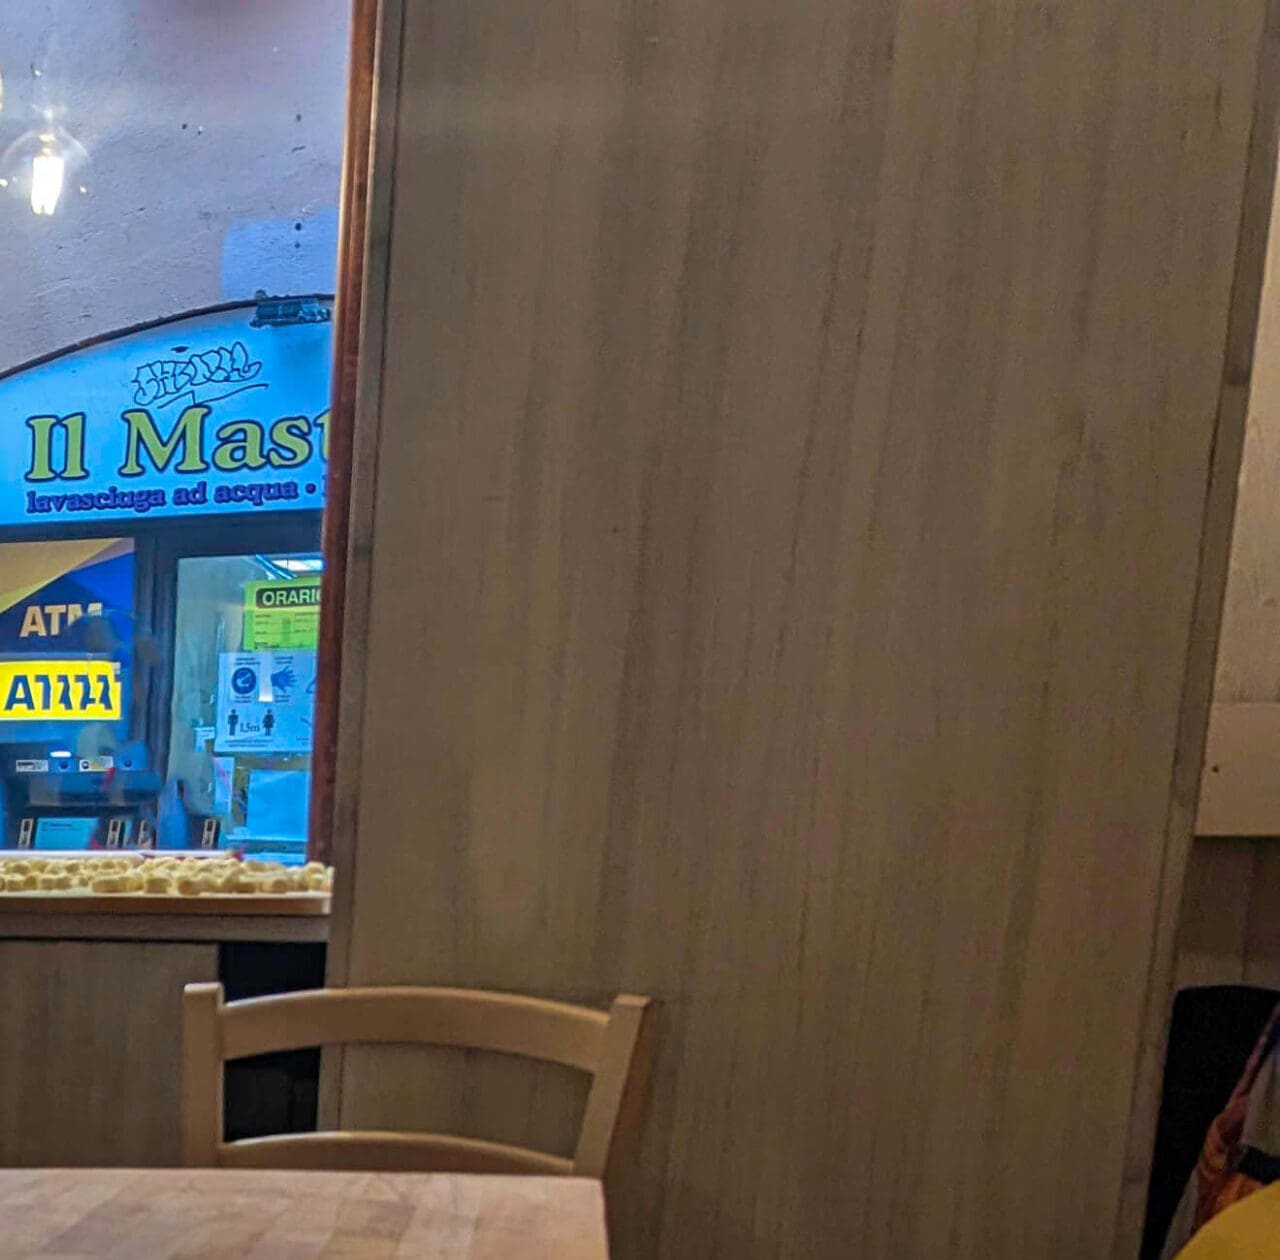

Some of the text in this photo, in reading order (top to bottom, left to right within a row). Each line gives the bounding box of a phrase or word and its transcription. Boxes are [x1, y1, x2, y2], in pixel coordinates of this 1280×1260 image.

[25, 411, 89, 483] Il
[26, 486, 167, 513] lavasciuga
[173, 481, 208, 506] ad
[214, 481, 299, 506] acqua
